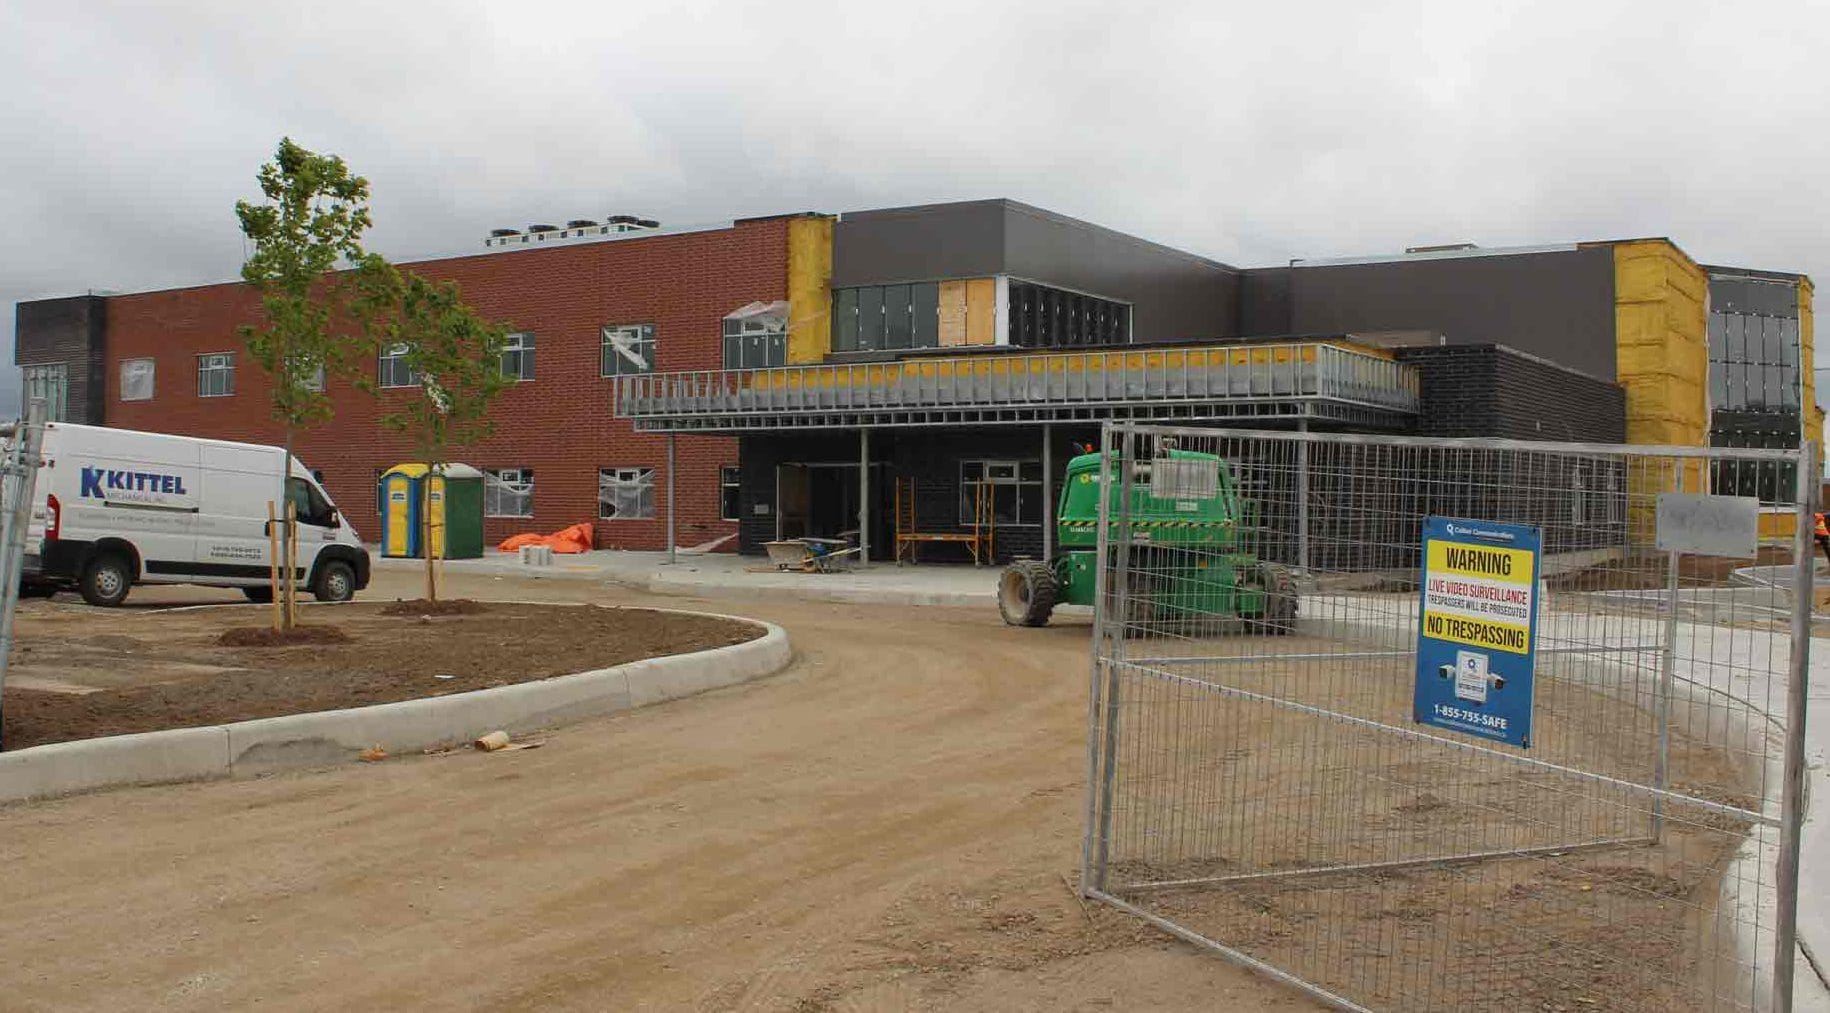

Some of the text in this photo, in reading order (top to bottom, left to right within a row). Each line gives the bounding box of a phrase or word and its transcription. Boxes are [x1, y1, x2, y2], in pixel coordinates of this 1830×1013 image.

[106, 470, 187, 494] KITTEL
[1446, 547, 1512, 576] WARNING
[1428, 578, 1527, 605] LIVE VIDEO SURVEILLANCE
[1428, 594, 1527, 619] TRESPASSERS WILL BE PROSECUTED
[1427, 615, 1524, 649] NO TRESPASSING
[1434, 703, 1507, 729] 1-855-755-SAFE
